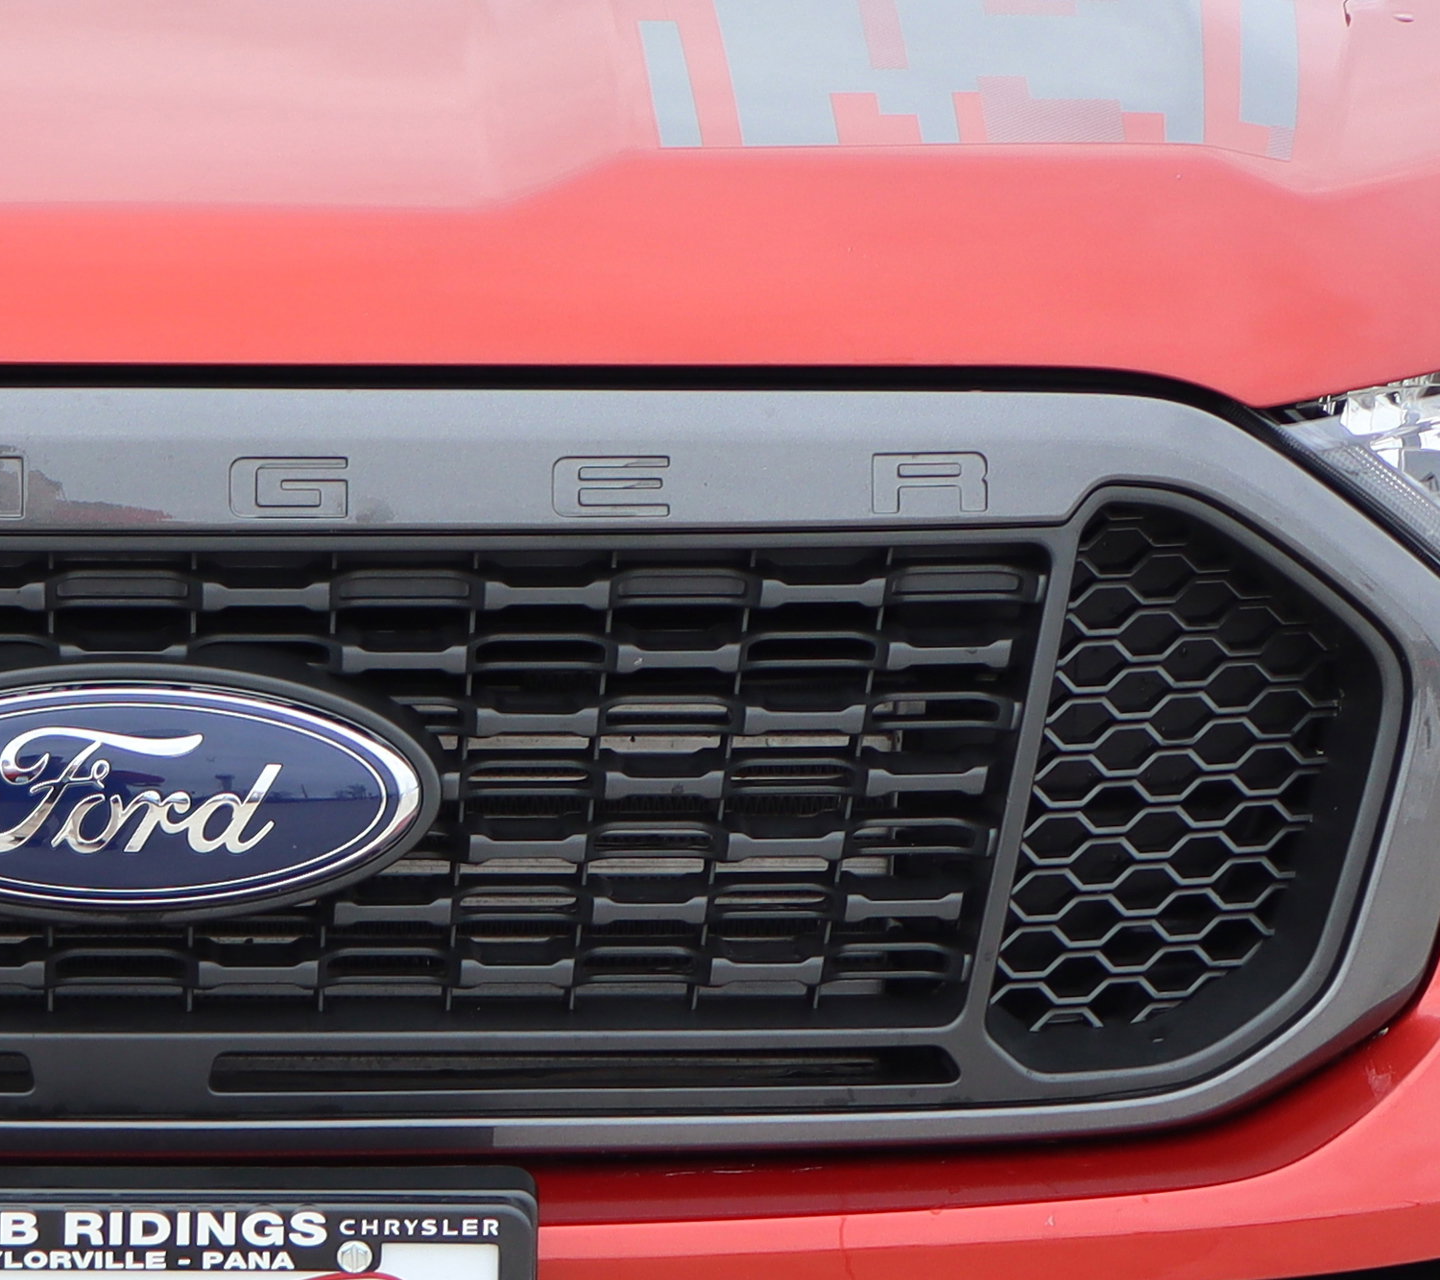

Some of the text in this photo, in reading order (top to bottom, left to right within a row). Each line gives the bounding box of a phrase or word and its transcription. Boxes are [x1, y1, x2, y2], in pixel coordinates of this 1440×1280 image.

[64, 1210, 327, 1247] RIDINGS
[339, 1218, 499, 1237] CHRYSLER
[202, 1250, 296, 1270] PANA
